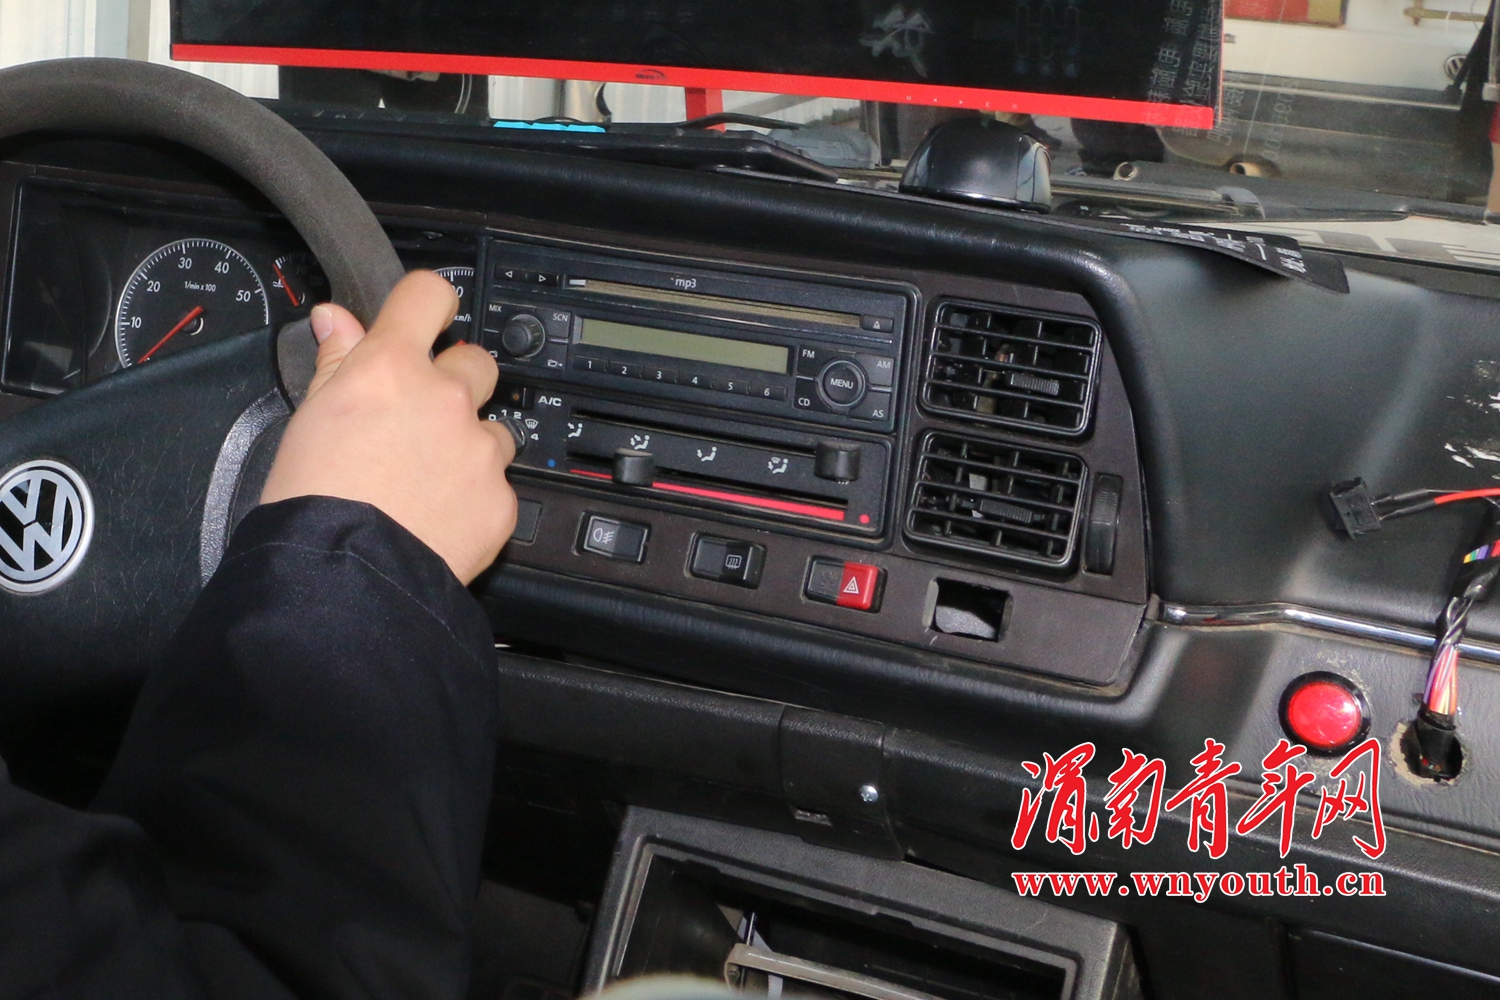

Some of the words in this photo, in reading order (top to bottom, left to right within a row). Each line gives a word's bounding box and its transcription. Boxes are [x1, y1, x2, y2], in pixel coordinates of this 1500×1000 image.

[177, 256, 193, 271] 30
[213, 260, 230, 275] 40
[146, 279, 161, 294] 20
[675, 277, 697, 289] mp3
[235, 289, 251, 303] 50
[489, 304, 502, 313] MIX
[130, 316, 142, 329] 10
[552, 312, 569, 323] SCN
[802, 349, 816, 359] FM
[587, 360, 592, 369] 1
[876, 360, 891, 369] AM
[621, 366, 627, 375] 2
[656, 371, 662, 379] 3
[692, 376, 698, 385] 4
[830, 377, 854, 390] MENU
[728, 382, 733, 391] 5
[764, 388, 770, 396] 6
[538, 395, 562, 407] A/C
[798, 397, 811, 407] CD
[501, 409, 508, 417] 1
[514, 411, 521, 419] 2
[872, 408, 884, 418] AS
[530, 433, 539, 441] 4
